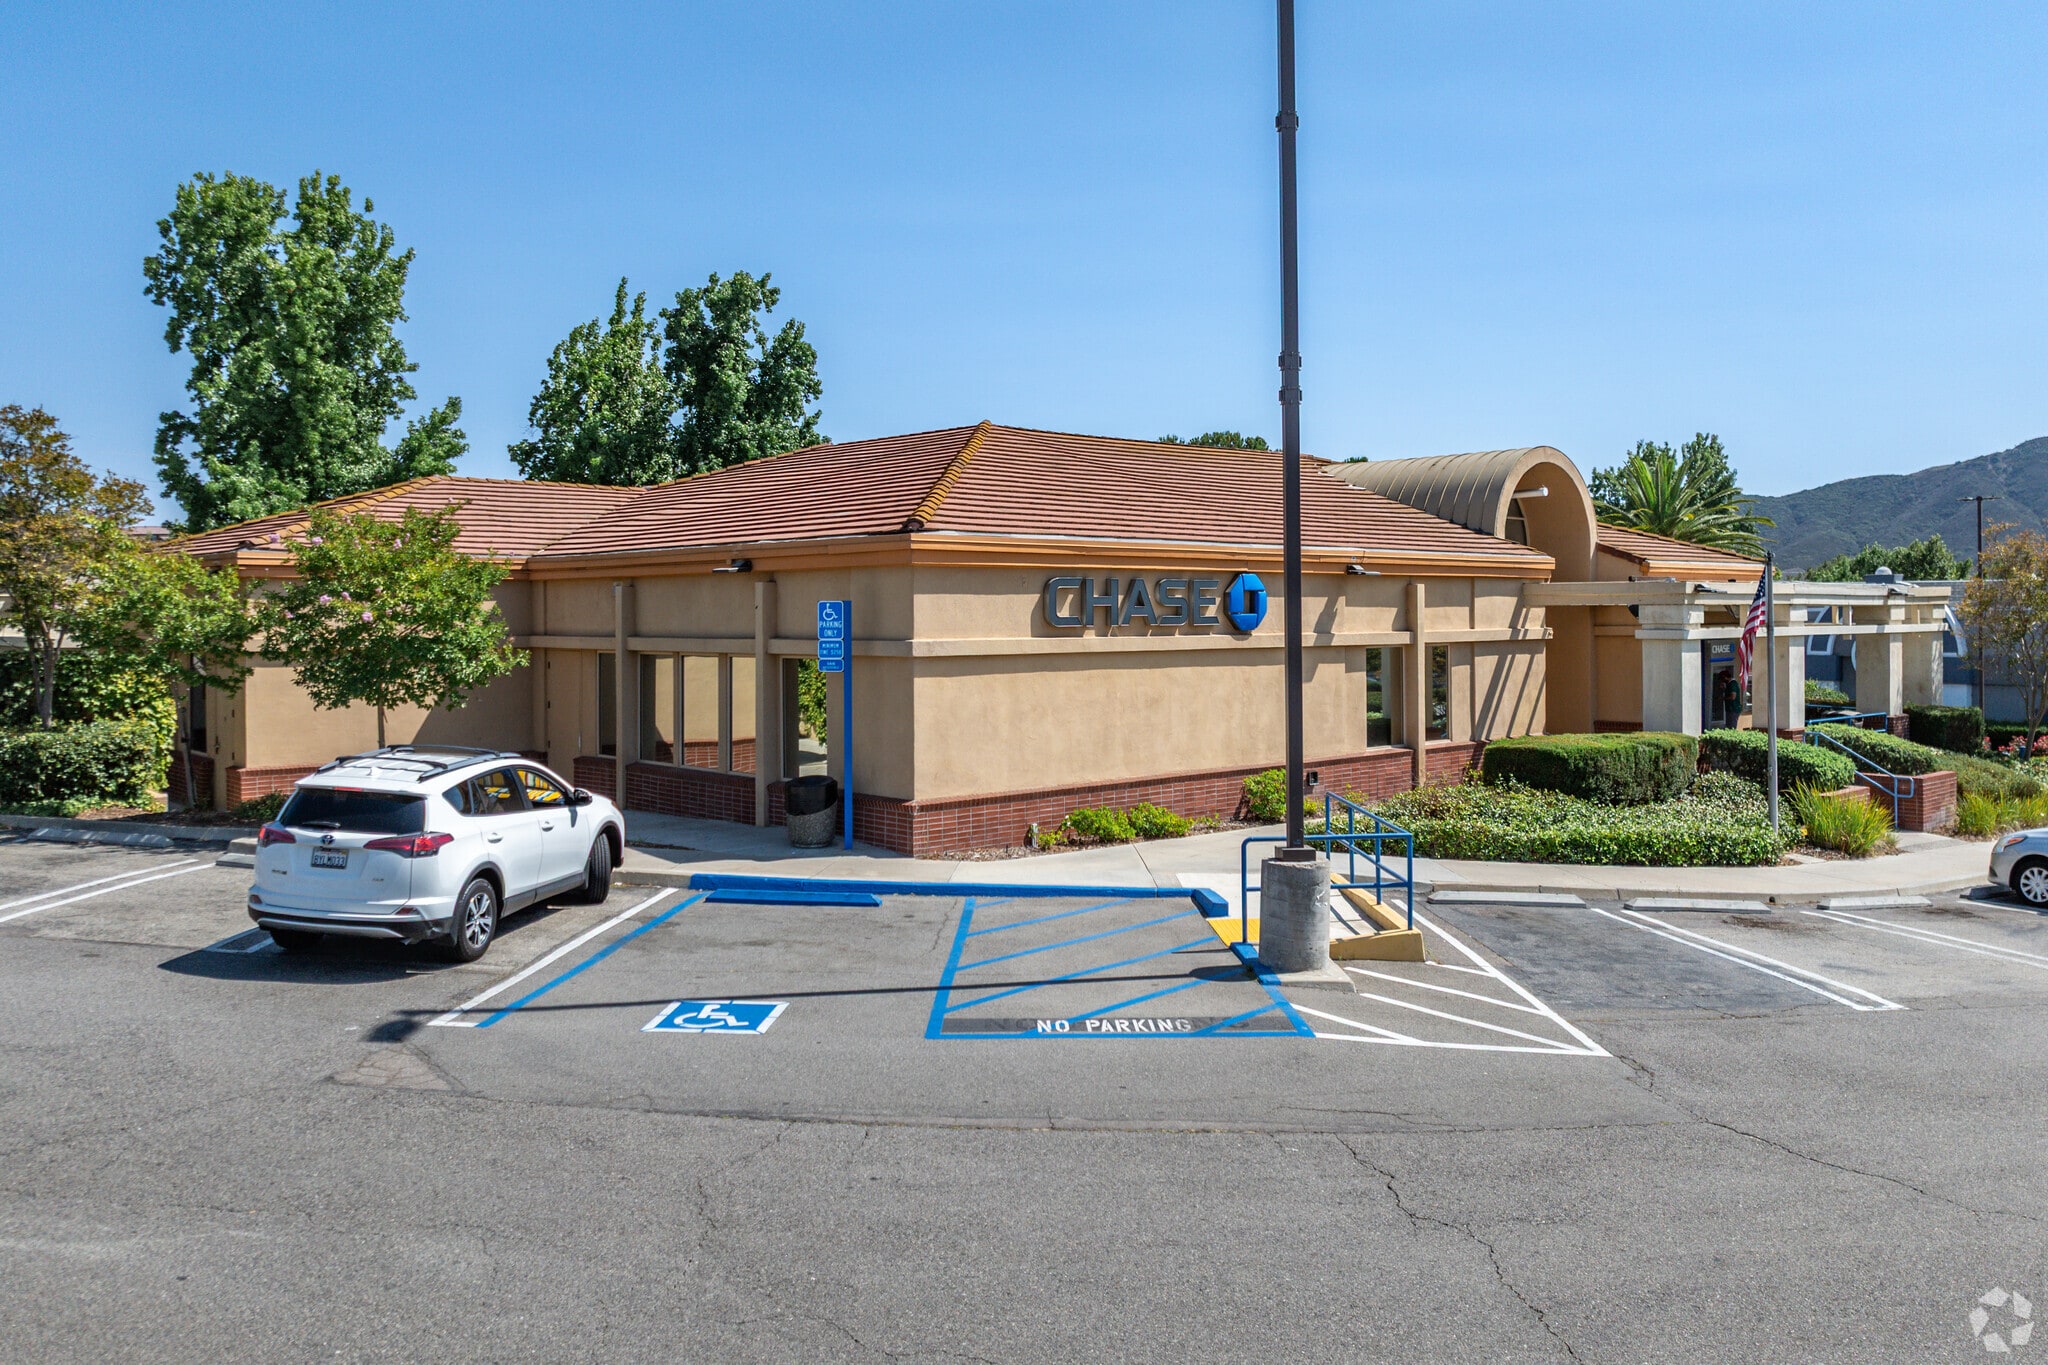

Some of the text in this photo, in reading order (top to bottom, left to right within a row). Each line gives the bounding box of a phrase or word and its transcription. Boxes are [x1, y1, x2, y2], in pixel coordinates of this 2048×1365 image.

[1045, 576, 1220, 628] CHASE
[823, 629, 838, 637] ONLY
[1711, 644, 1730, 653] CHASE
[1037, 1019, 1070, 1033] NO
[1086, 1019, 1192, 1033] PARKING
